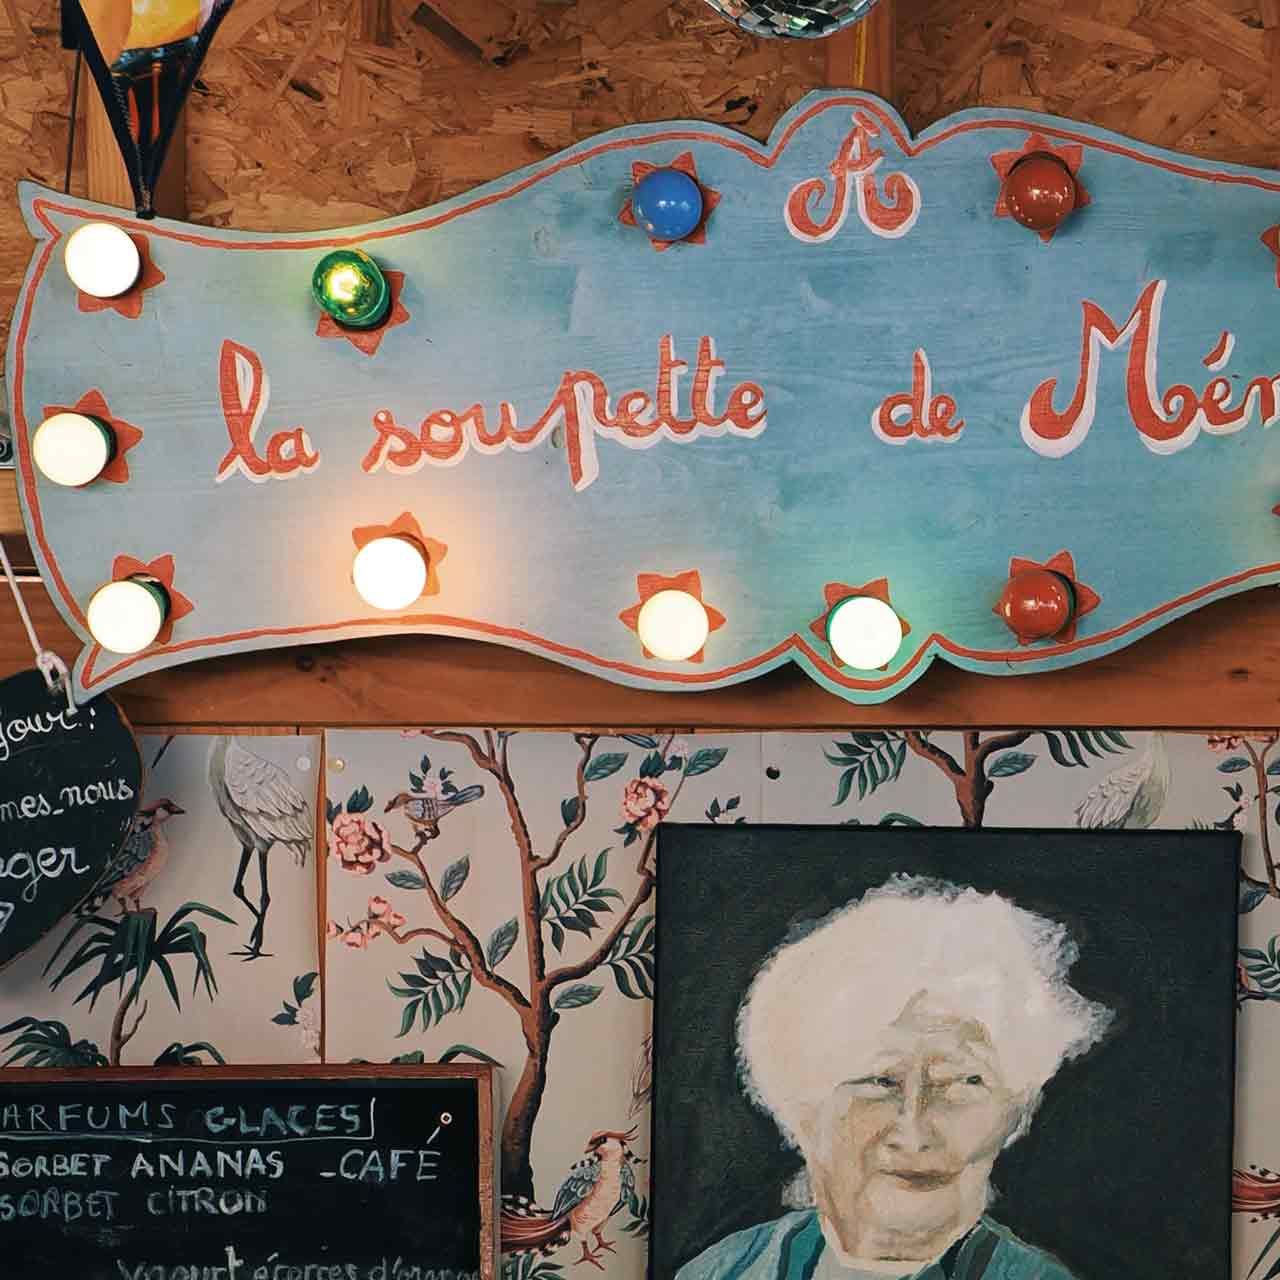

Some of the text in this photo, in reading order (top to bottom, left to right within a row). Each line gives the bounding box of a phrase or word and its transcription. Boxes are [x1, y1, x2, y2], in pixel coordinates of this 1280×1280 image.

[785, 111, 919, 241] À
[216, 338, 320, 482] la
[361, 334, 767, 491] soupette
[873, 347, 965, 444] de
[2, 1101, 177, 1130] ARFUMS
[0, 1151, 112, 1178] SORBET
[130, 1149, 285, 1179] ANANAS
[0, 1187, 120, 1222] SORBET
